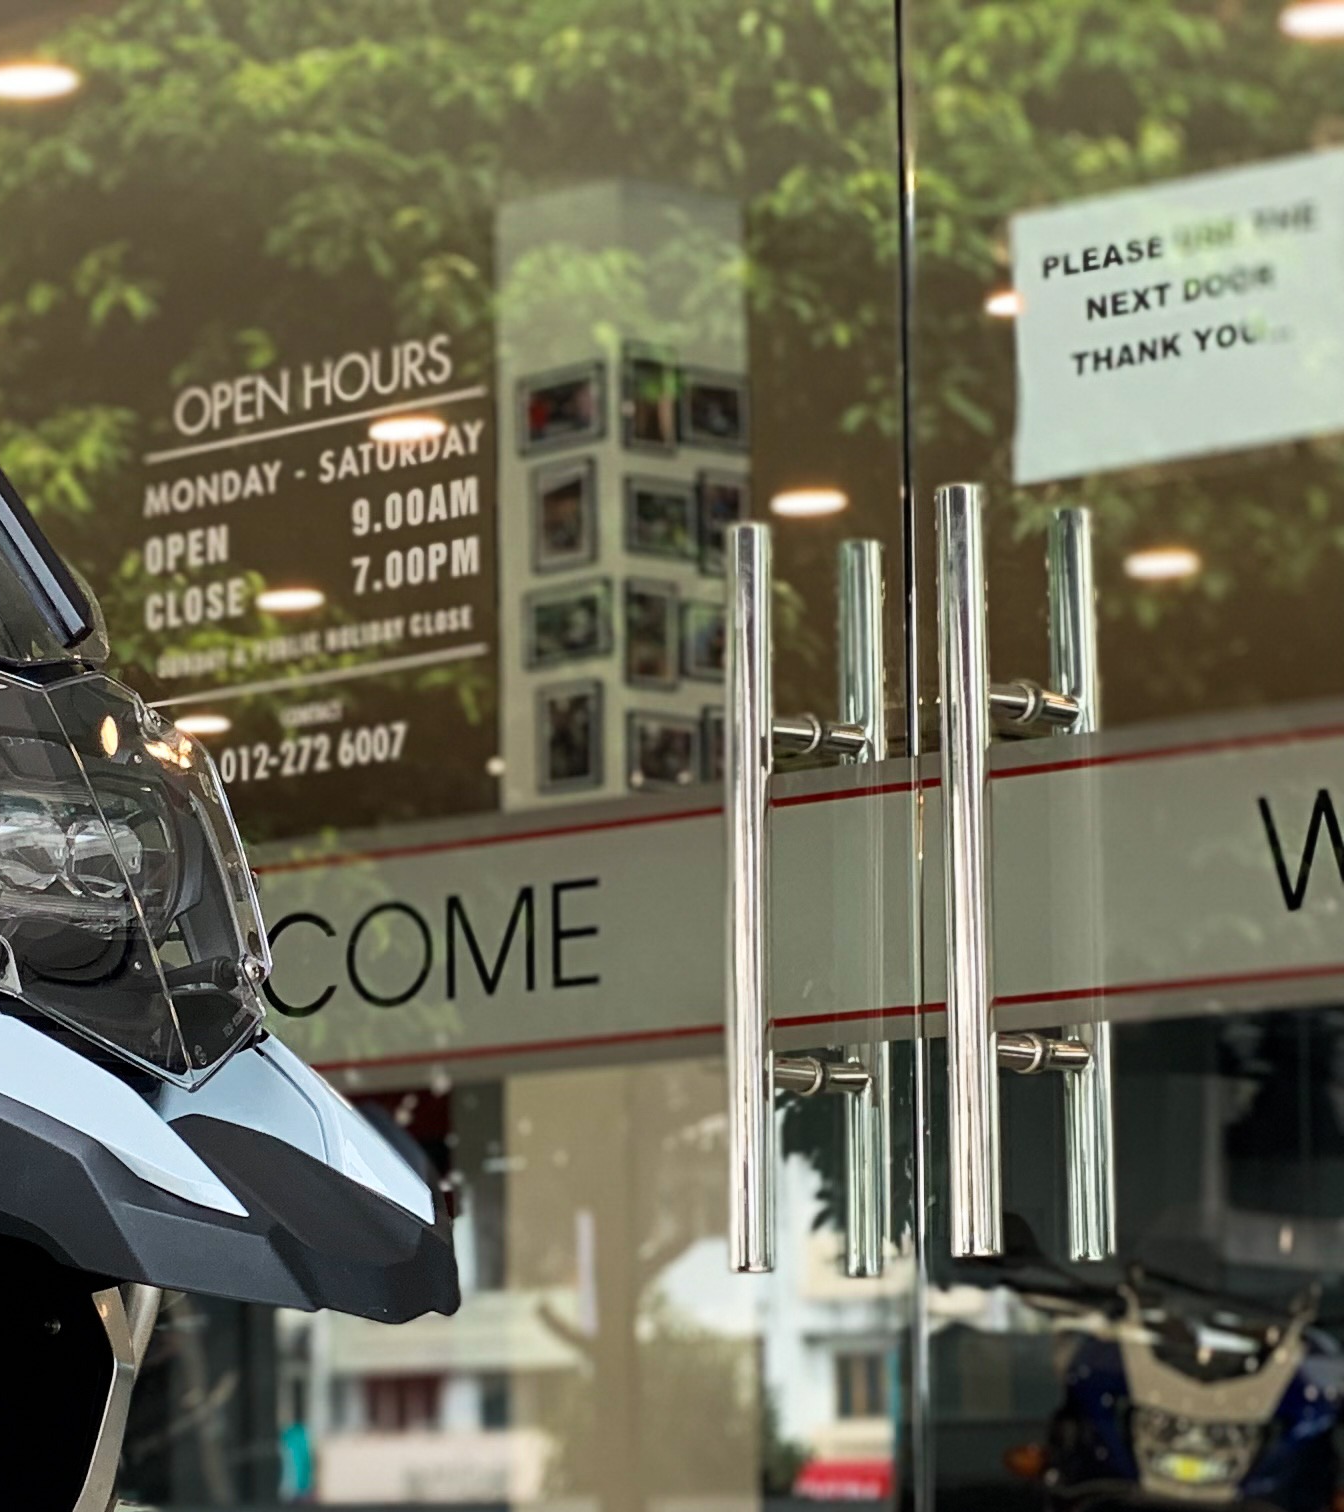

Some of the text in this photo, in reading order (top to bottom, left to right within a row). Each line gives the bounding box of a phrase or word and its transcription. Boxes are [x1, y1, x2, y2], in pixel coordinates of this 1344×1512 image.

[1042, 235, 1164, 279] PLEASE
[1086, 282, 1172, 320] NEXT
[174, 334, 452, 435] OPEN HOURS
[1070, 332, 1182, 376] THANK
[144, 459, 282, 517] MONDAY
[318, 420, 484, 483] SATURDAY
[145, 477, 479, 576] OPEN 9.00AM
[145, 536, 479, 631] CLOSE 7.00PM
[410, 606, 473, 637] CLOSE
[220, 721, 408, 783] 012-272 6007
